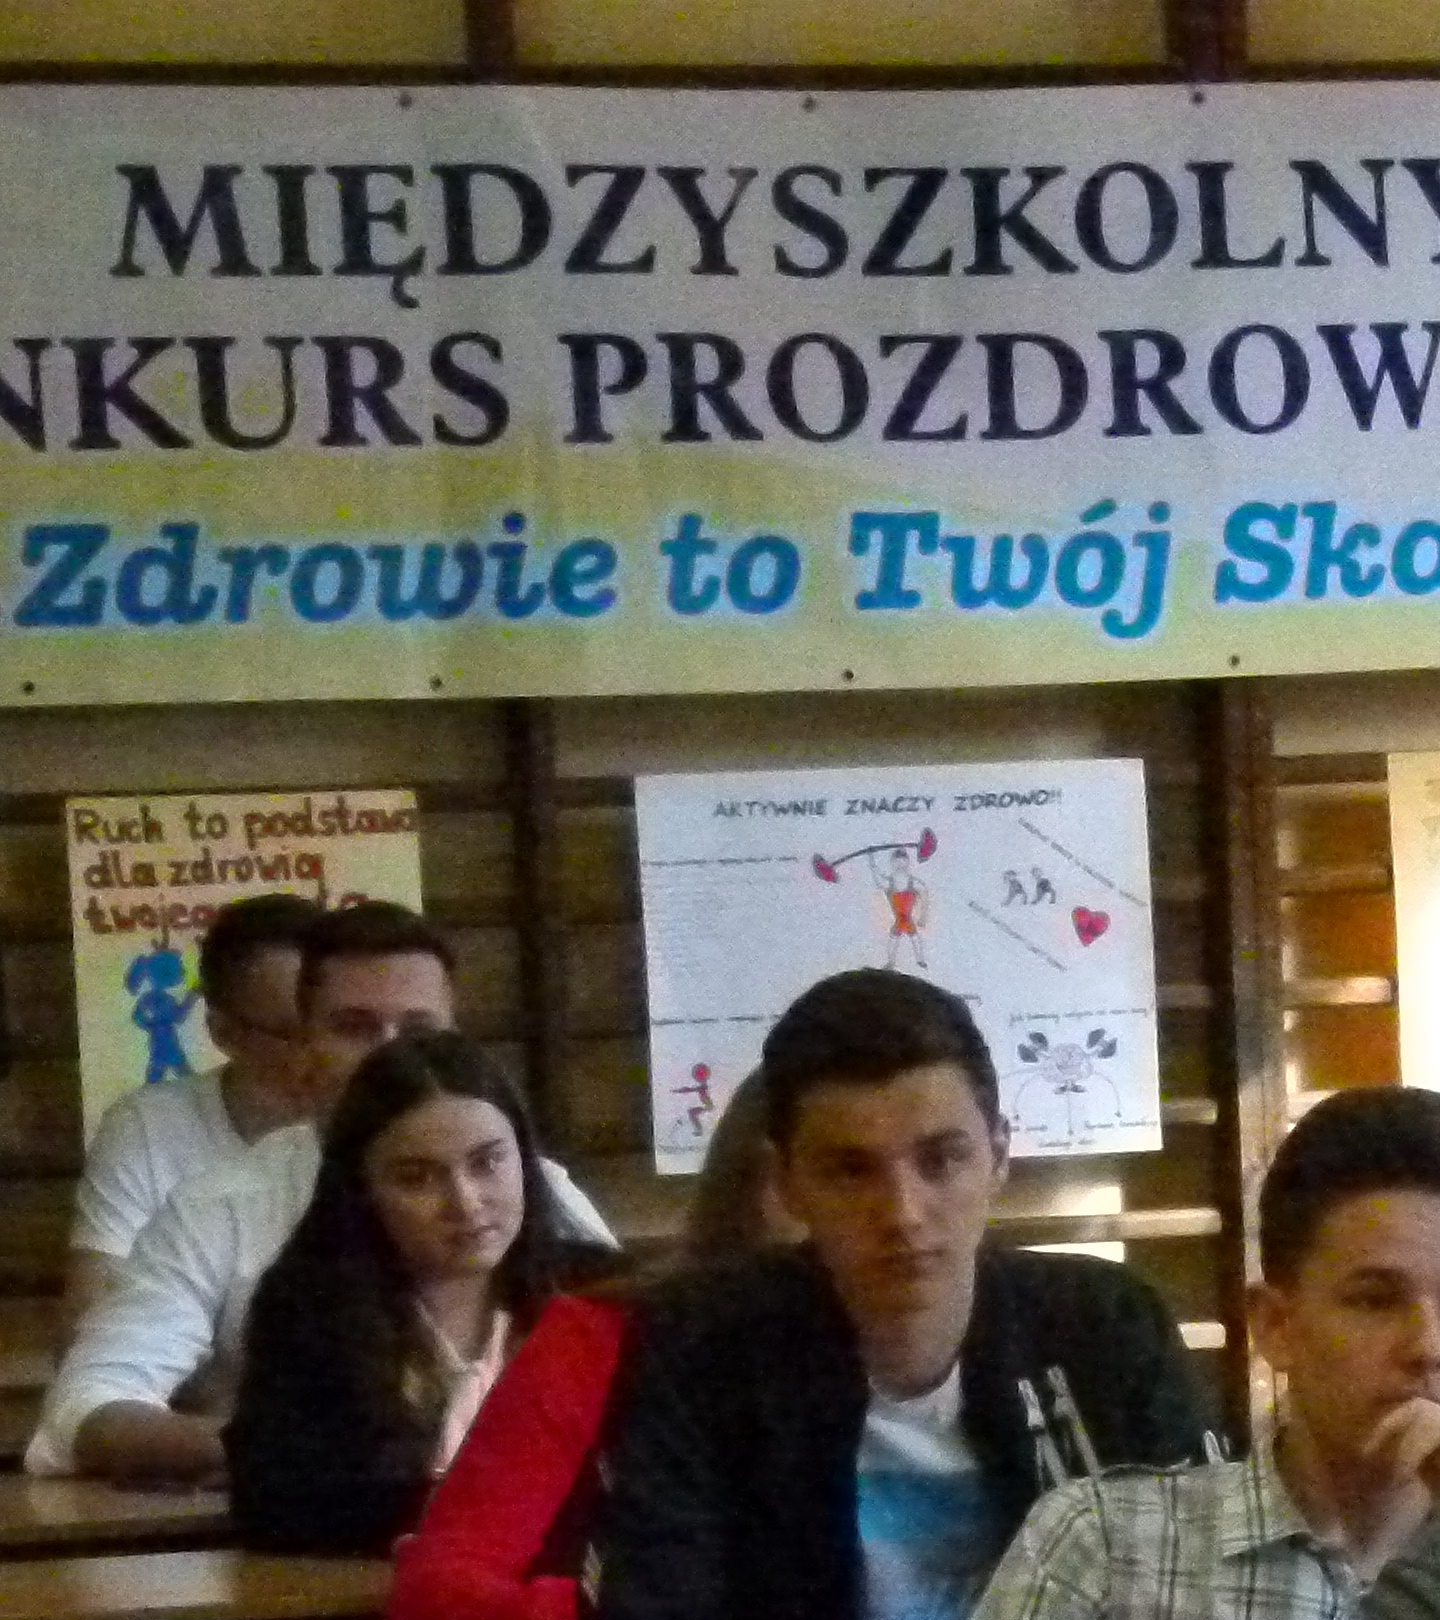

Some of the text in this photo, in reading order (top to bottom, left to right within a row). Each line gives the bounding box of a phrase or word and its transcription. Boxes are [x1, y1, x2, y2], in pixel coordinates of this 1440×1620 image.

[13, 511, 619, 628] Zdrowie
[660, 511, 802, 616] to
[848, 497, 1171, 640] Twój
[73, 803, 164, 844] Ruch
[183, 801, 229, 840] to
[712, 798, 828, 818] AKTYWNIE
[843, 795, 936, 817] ZNACZY
[83, 849, 157, 888] dla
